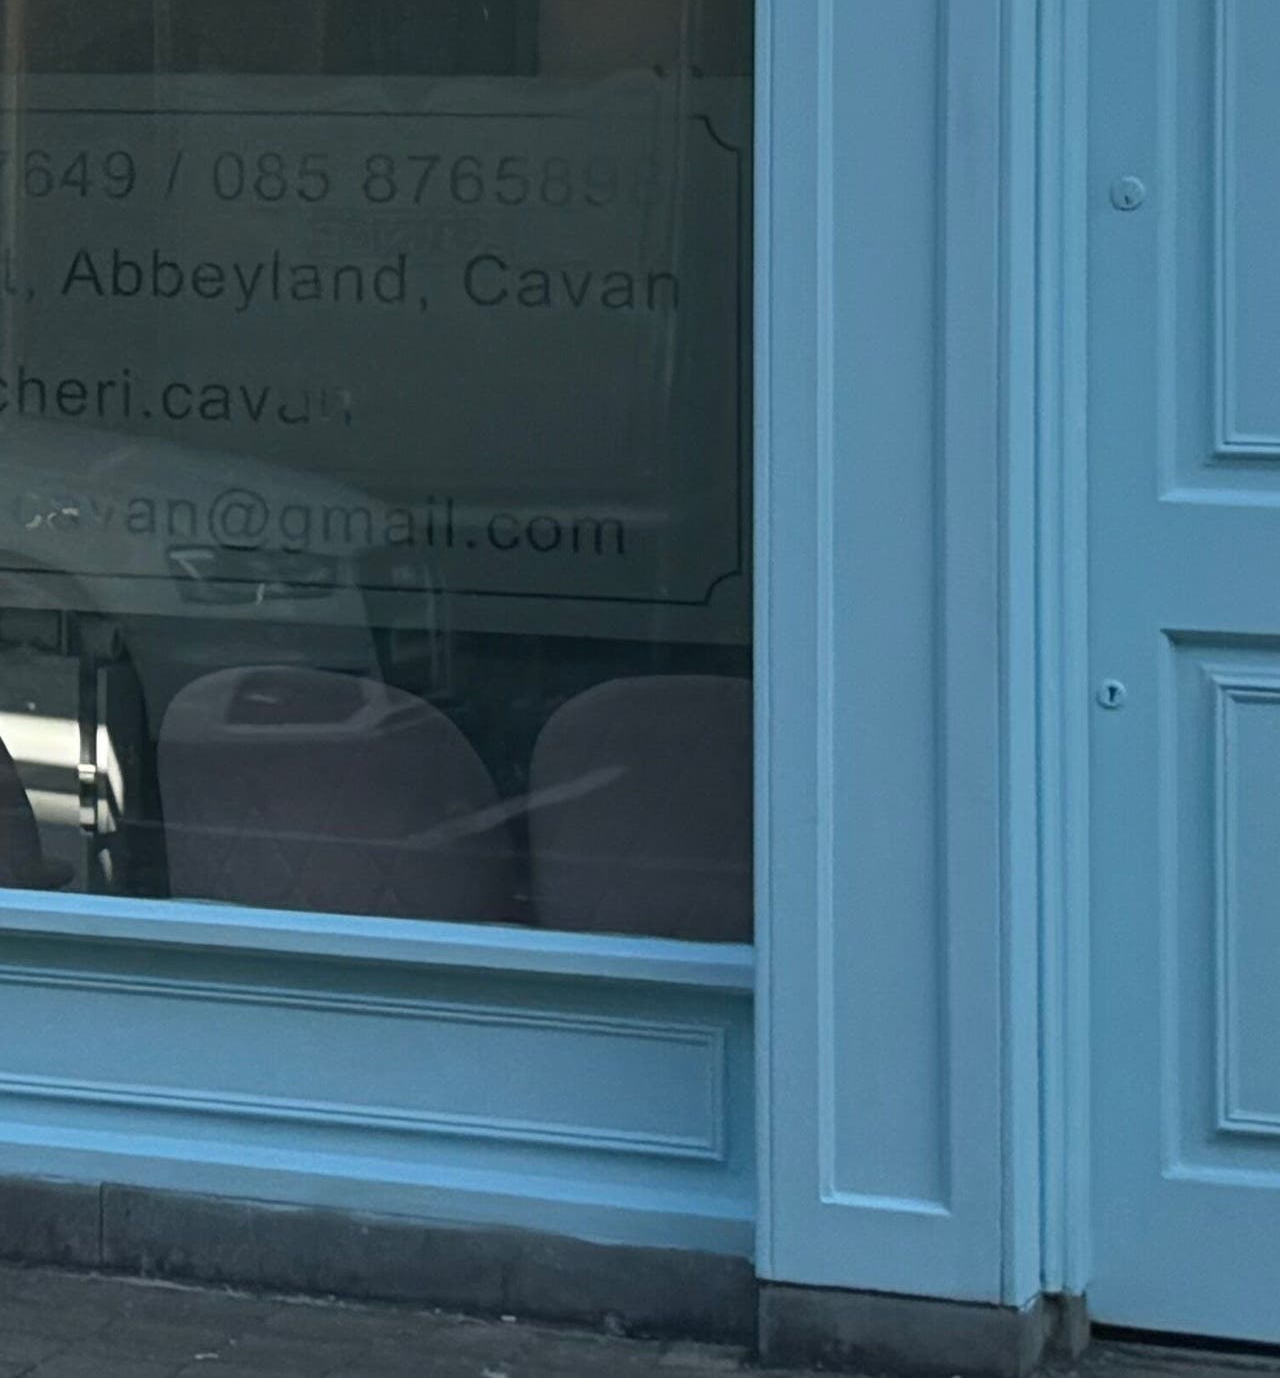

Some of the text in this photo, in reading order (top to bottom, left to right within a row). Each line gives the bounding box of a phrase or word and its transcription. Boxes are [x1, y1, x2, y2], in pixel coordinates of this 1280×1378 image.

[164, 148, 184, 200] /
[212, 150, 331, 204] 085
[60, 247, 429, 314] Abbeyland,
[462, 253, 681, 312] Cavan
